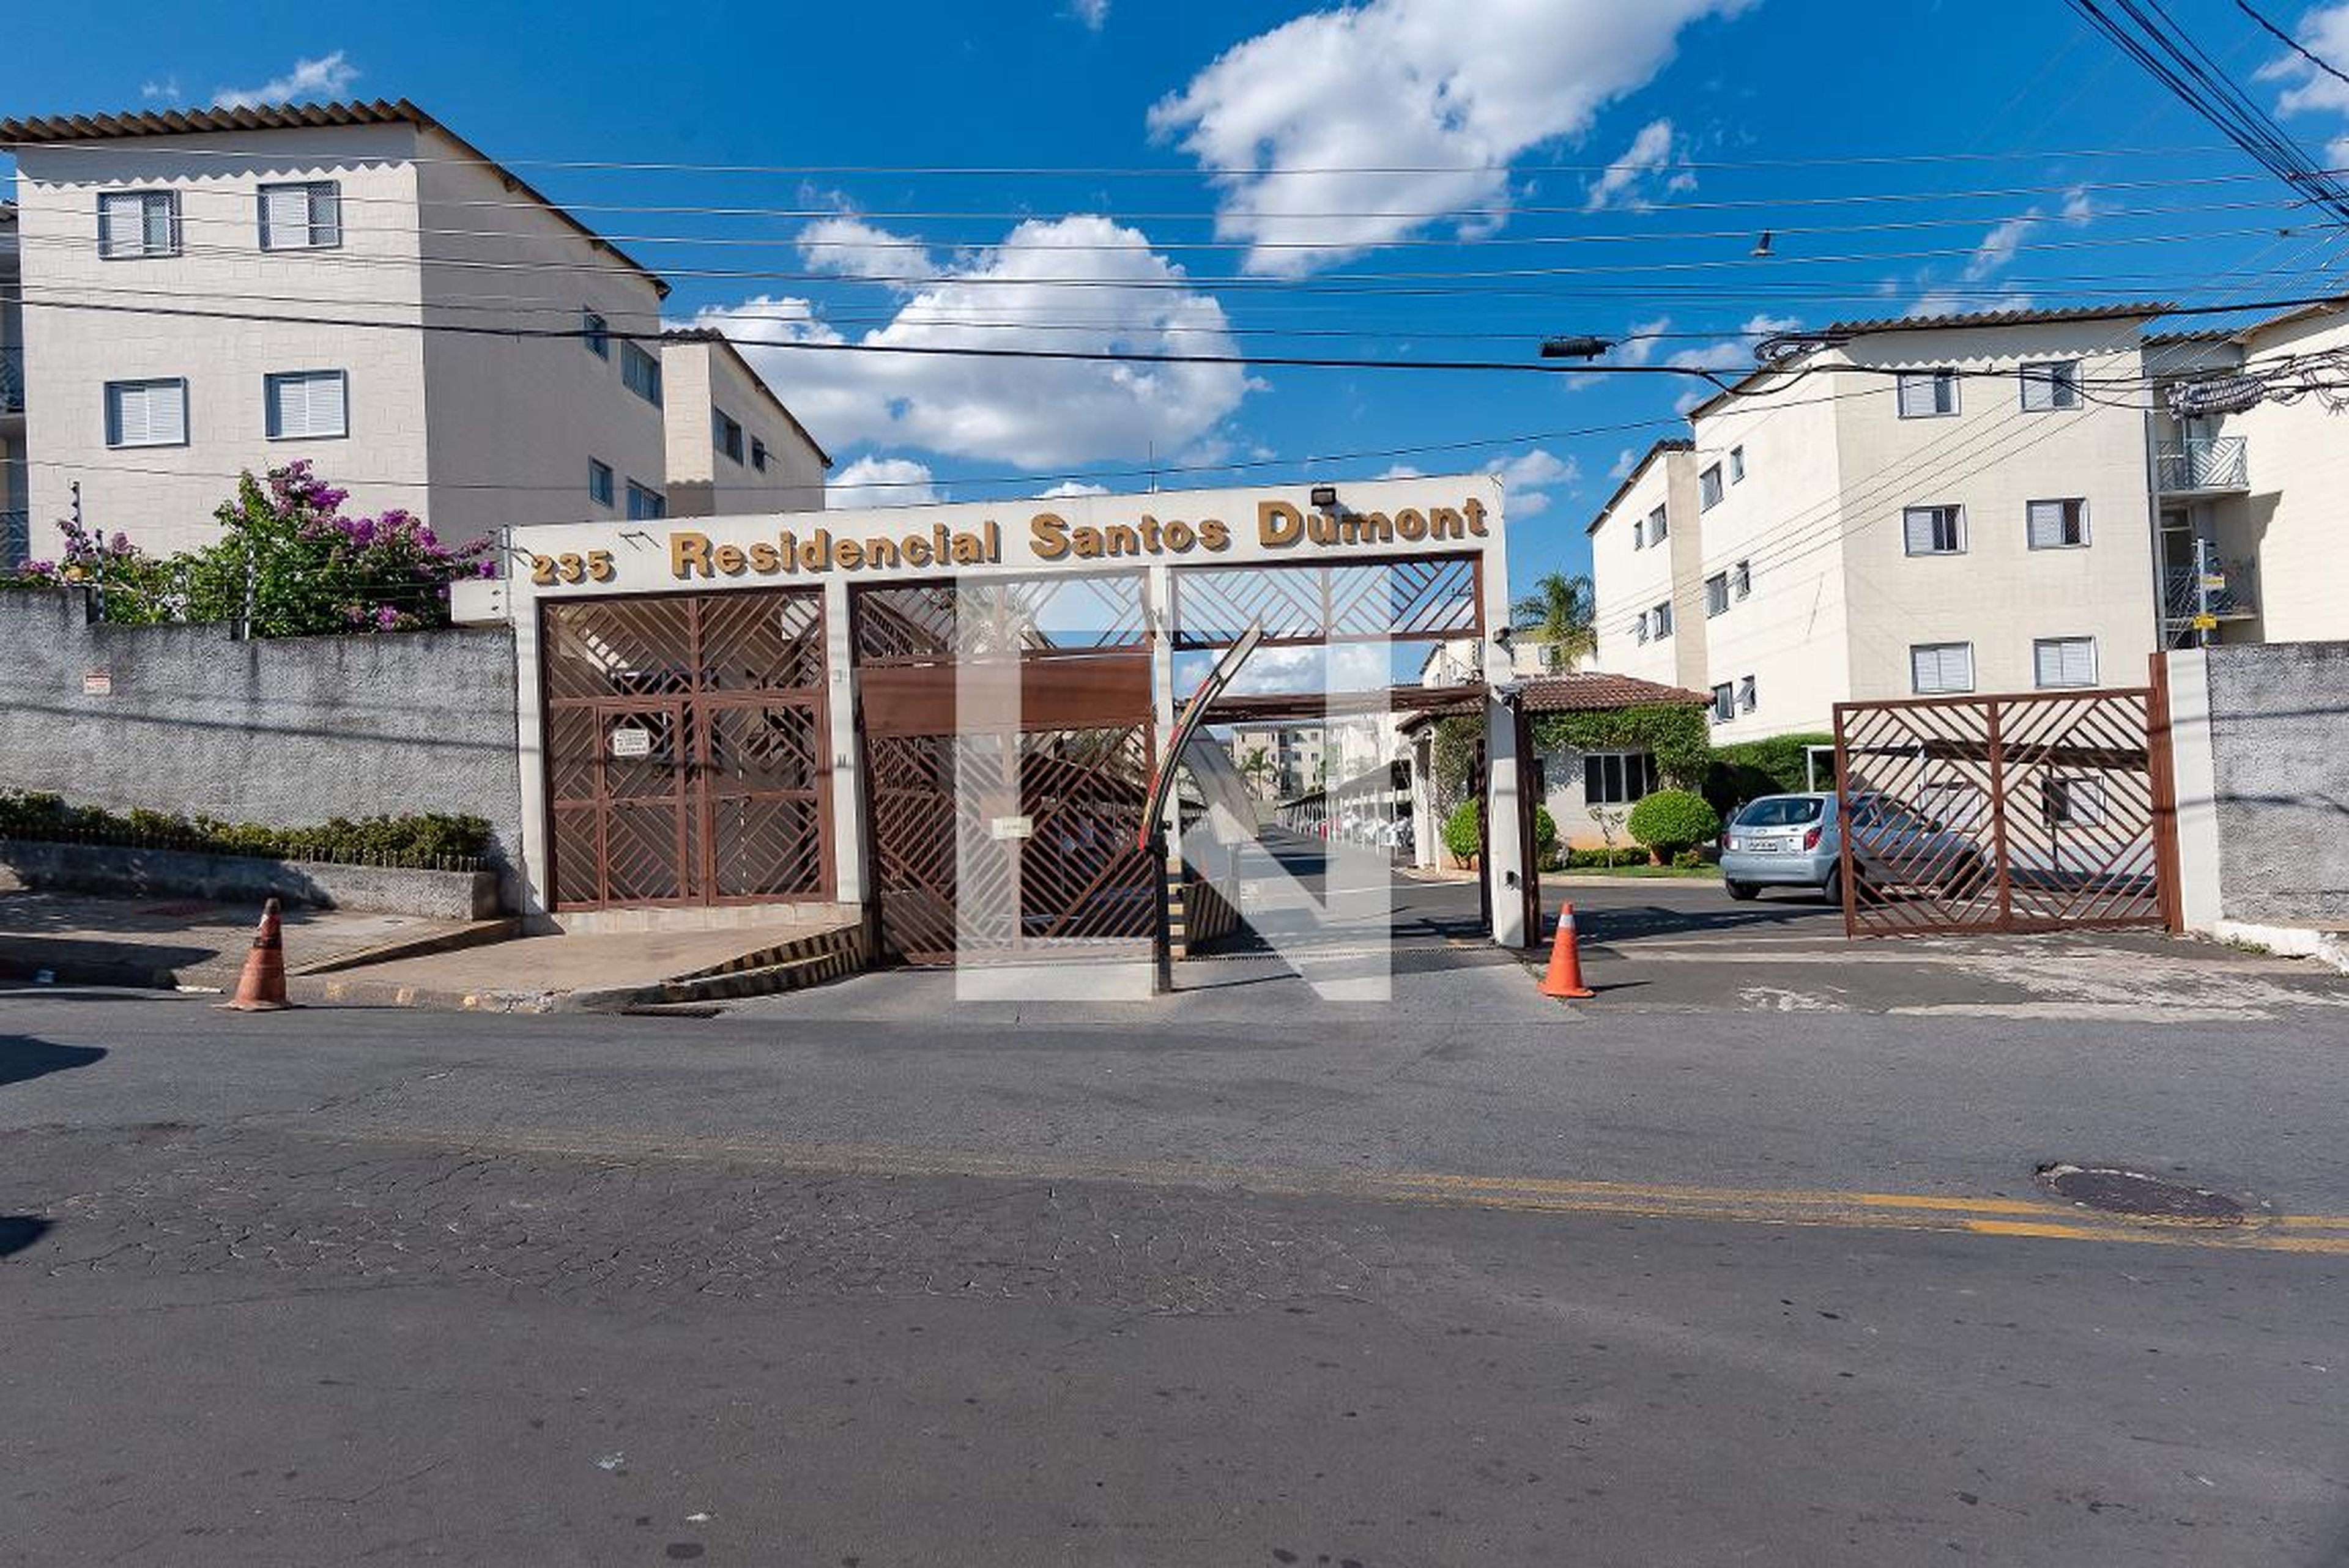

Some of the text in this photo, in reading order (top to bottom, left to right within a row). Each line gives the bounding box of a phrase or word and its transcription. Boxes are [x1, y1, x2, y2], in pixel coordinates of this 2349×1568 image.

[533, 498, 1489, 585] 235 Residencial Santos Dumont
